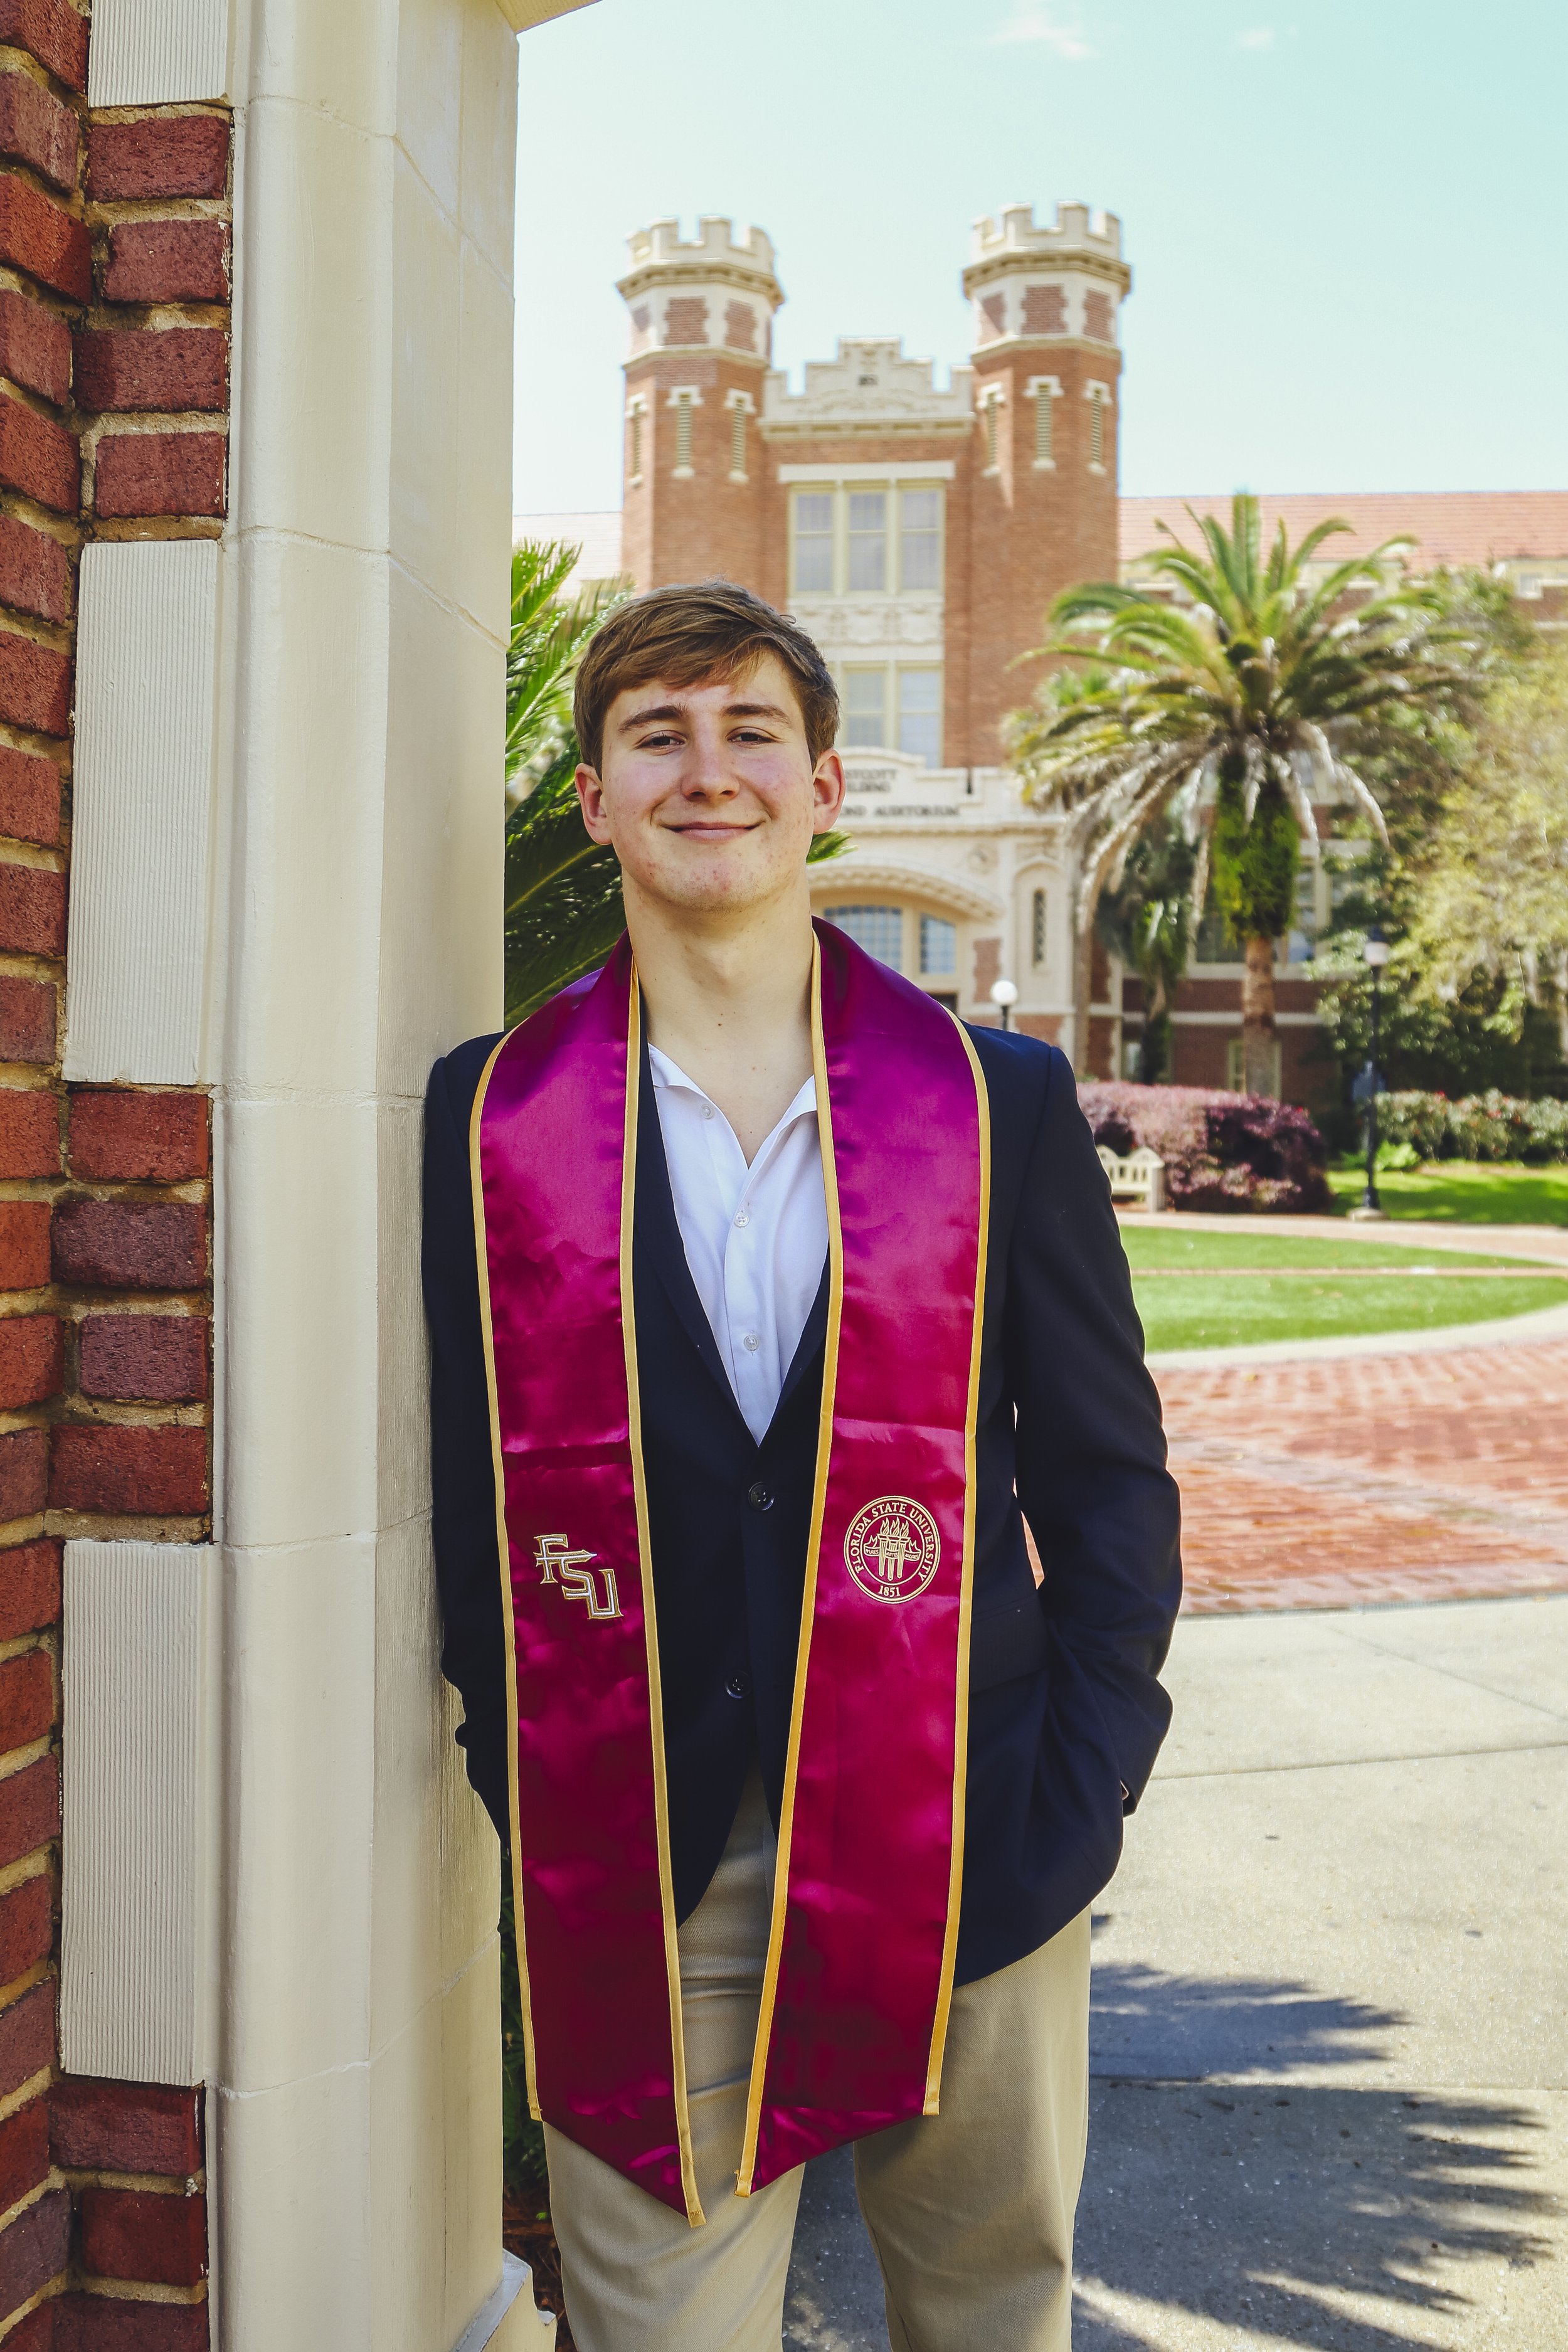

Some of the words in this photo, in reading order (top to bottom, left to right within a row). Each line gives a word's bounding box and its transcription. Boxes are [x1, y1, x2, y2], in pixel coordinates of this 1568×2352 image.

[533, 1534, 624, 1619] FSU
[850, 1517, 872, 1574] FLORIDA
[871, 1502, 907, 1517] STATE
[909, 1508, 935, 1582] UNIVERSITY
[878, 1585, 901, 1597] 1851
